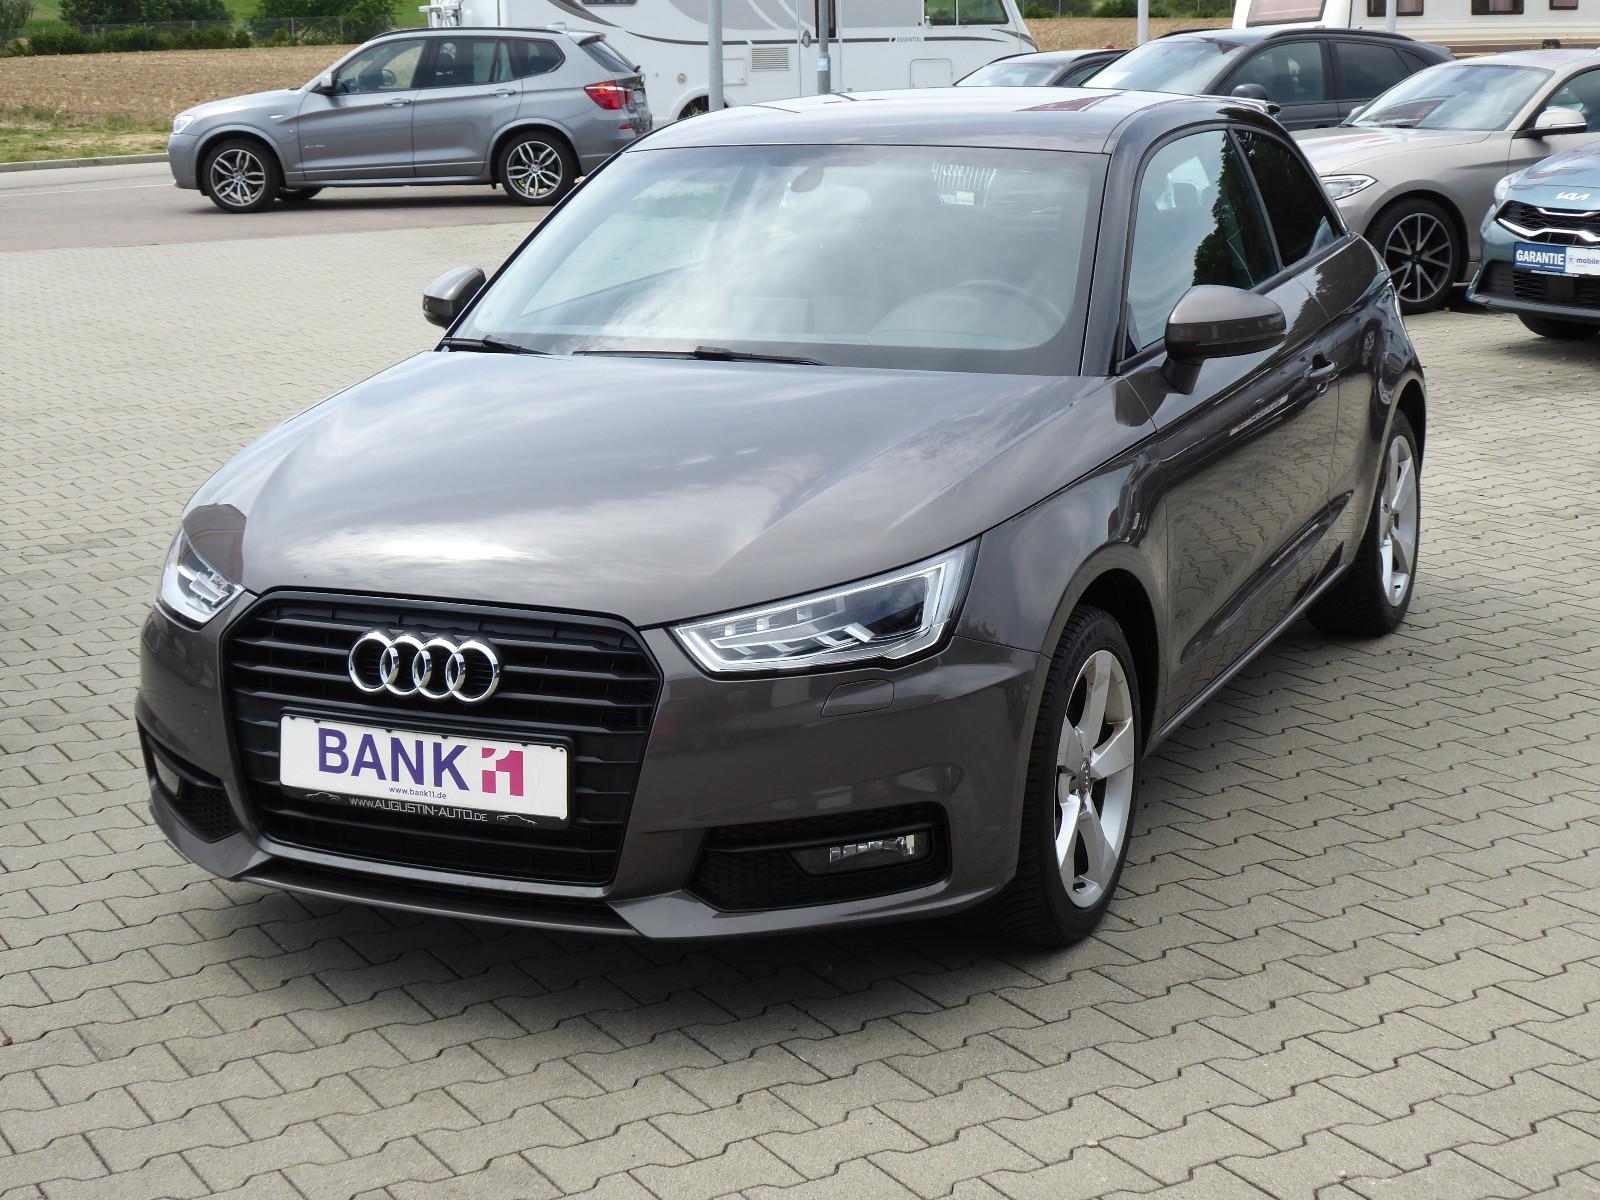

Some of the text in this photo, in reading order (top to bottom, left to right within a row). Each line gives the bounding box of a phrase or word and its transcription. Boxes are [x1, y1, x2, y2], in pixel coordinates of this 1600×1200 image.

[1516, 250, 1565, 265] GARANTIE
[318, 728, 470, 791] BANK
[389, 786, 447, 800] www.bank11.de
